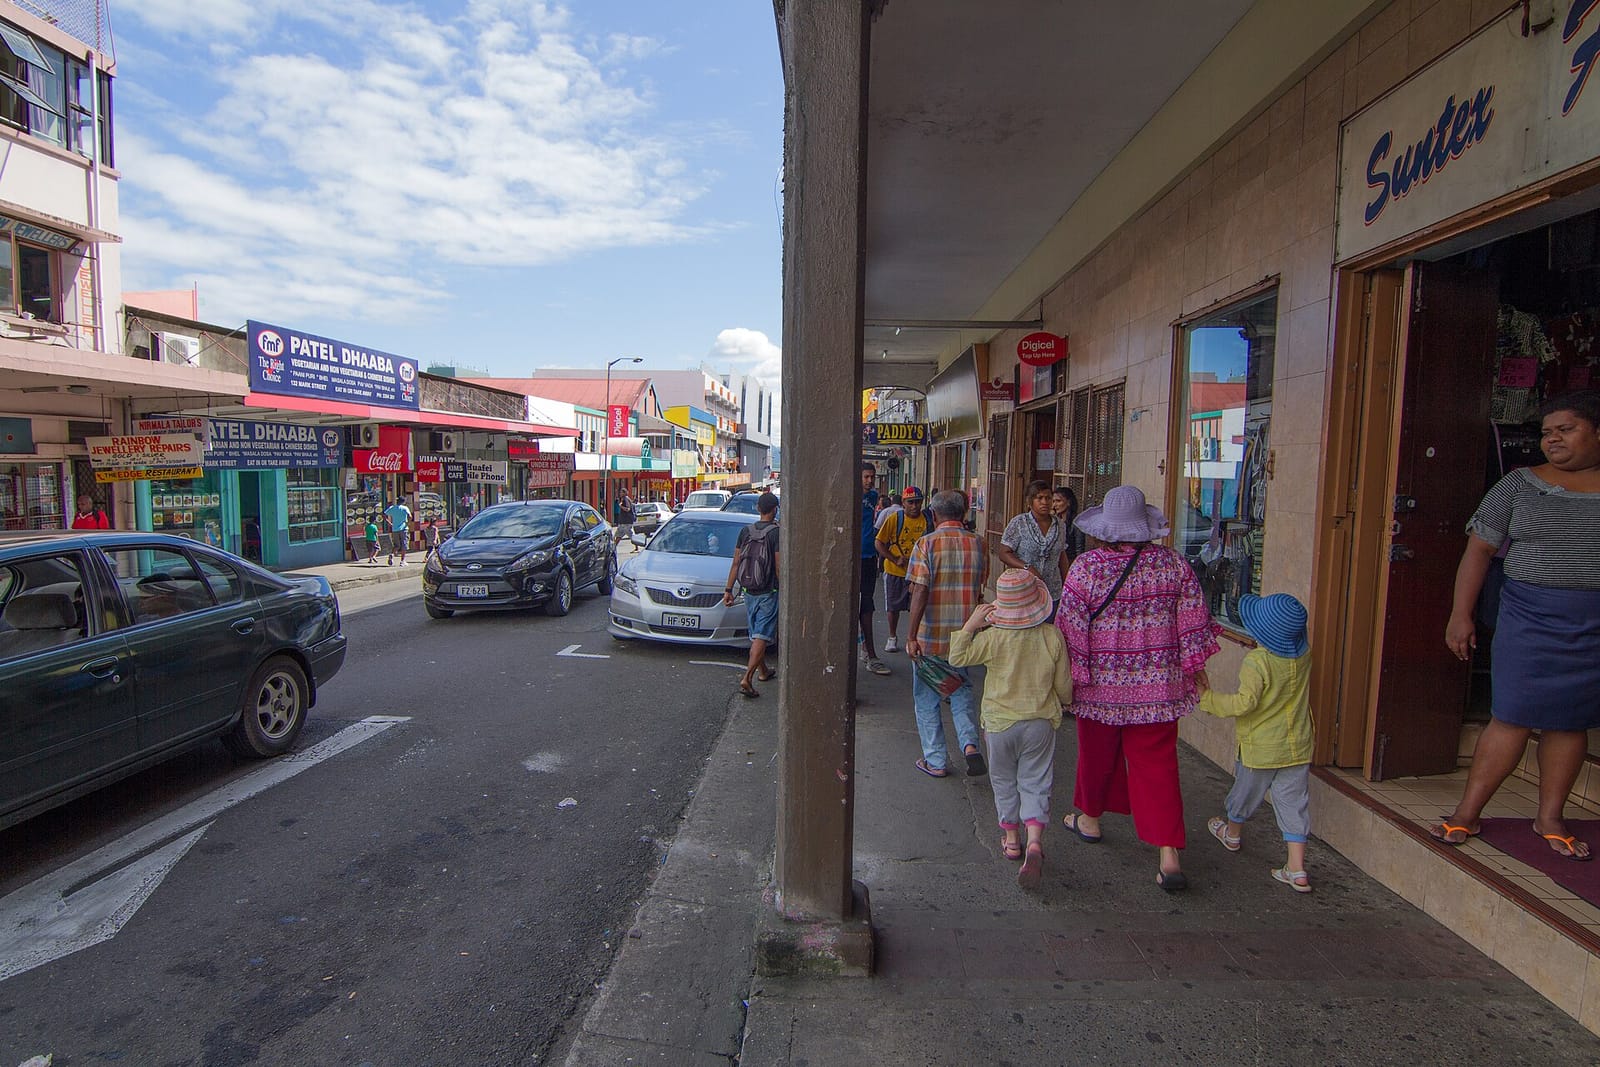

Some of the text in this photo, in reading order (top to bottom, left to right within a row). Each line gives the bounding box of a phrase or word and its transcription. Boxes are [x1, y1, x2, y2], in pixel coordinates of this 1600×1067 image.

[1364, 85, 1495, 226] Suntex
[262, 334, 281, 353] fmf
[1022, 340, 1054, 351] Digicel
[290, 336, 394, 374] PATEL DHAABA
[258, 356, 269, 368] The
[262, 370, 281, 383] Choice
[613, 407, 624, 435] Digicel
[208, 421, 249, 439] ATEL
[255, 423, 317, 442] DHAABA
[876, 424, 924, 439] PADDY'S
[112, 436, 160, 446] RAINBOW
[91, 443, 192, 455] JEWELLERY REPAIRS
[117, 470, 143, 478] EDGE
[144, 467, 197, 477] RESTAURANT
[480, 472, 504, 481] Phone
